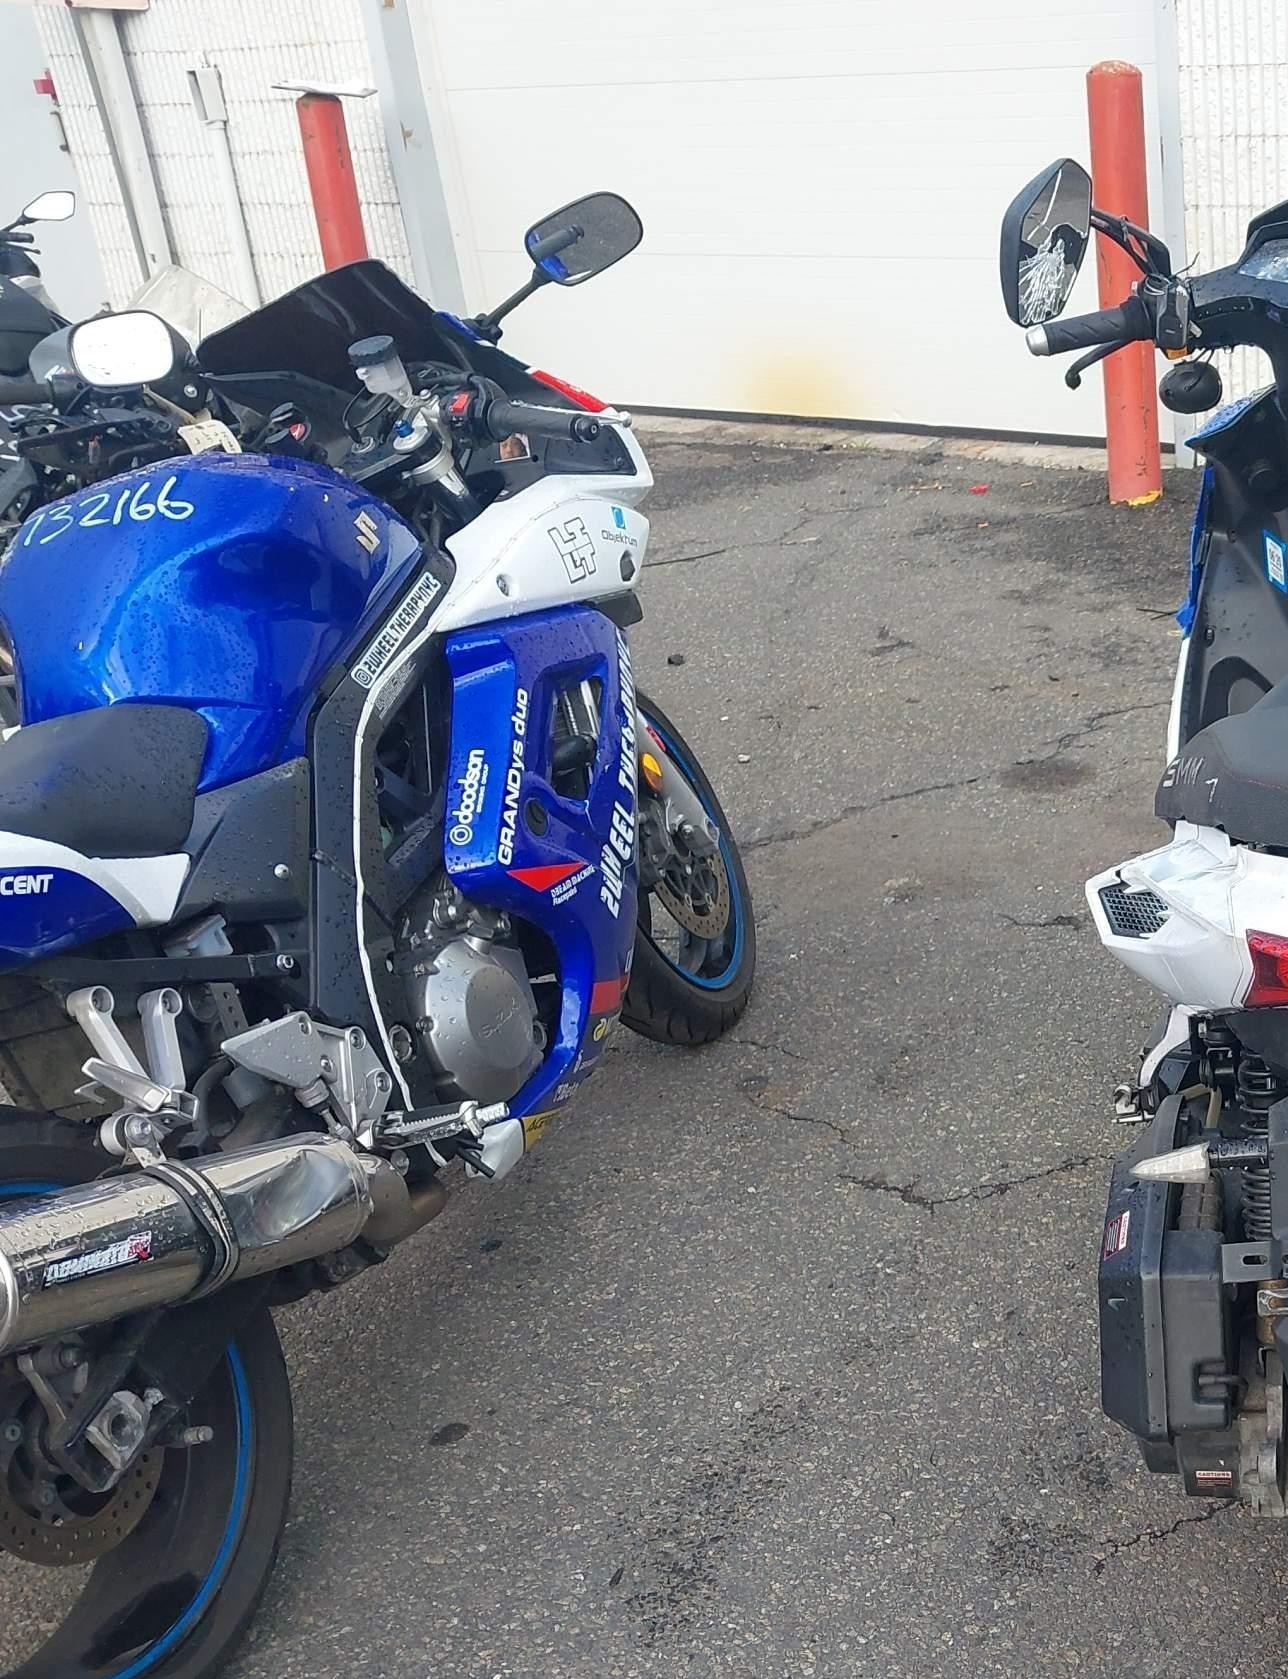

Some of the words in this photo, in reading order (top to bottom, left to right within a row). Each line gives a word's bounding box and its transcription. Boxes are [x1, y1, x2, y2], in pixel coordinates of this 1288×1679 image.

[511, 688, 529, 736] duo
[452, 749, 485, 824] doodson
[498, 740, 525, 866] GRANDys
